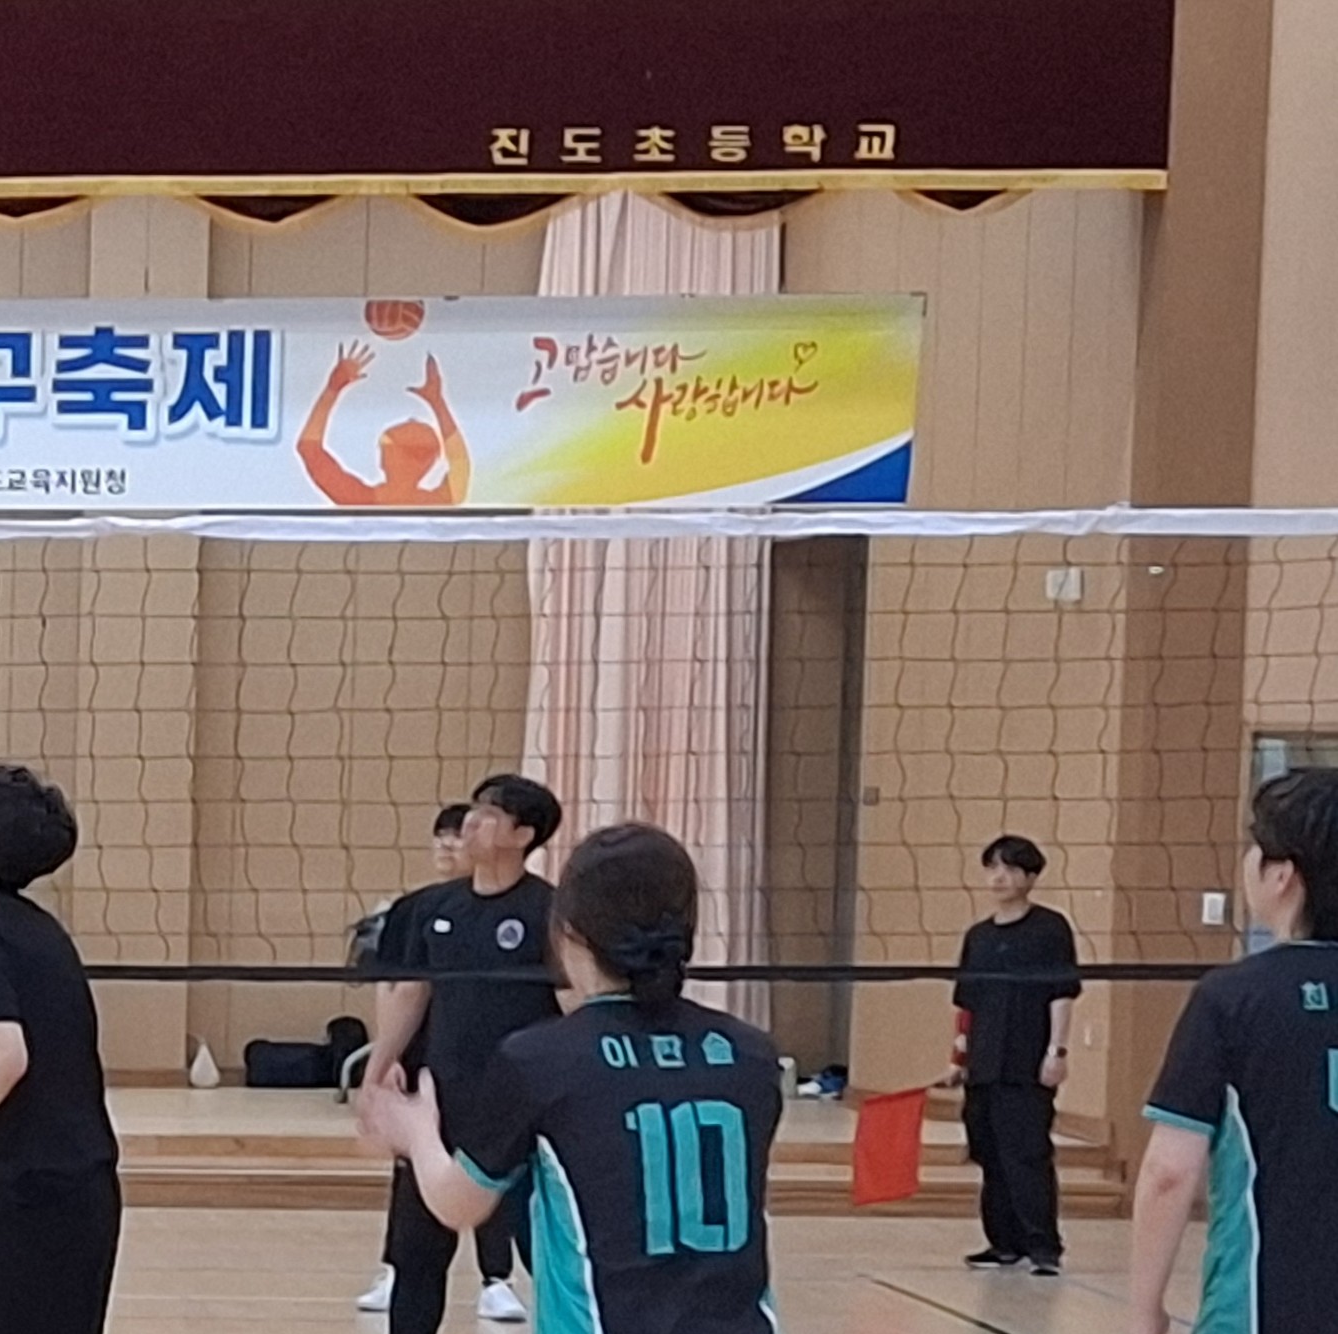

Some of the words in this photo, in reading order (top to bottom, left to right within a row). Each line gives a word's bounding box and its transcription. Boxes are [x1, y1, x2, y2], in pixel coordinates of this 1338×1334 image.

[490, 124, 896, 165] 진도초등학교
[516, 335, 708, 412] 고맙습니다
[615, 375, 819, 464] 사랑합니다
[624, 1100, 749, 1255] 10
